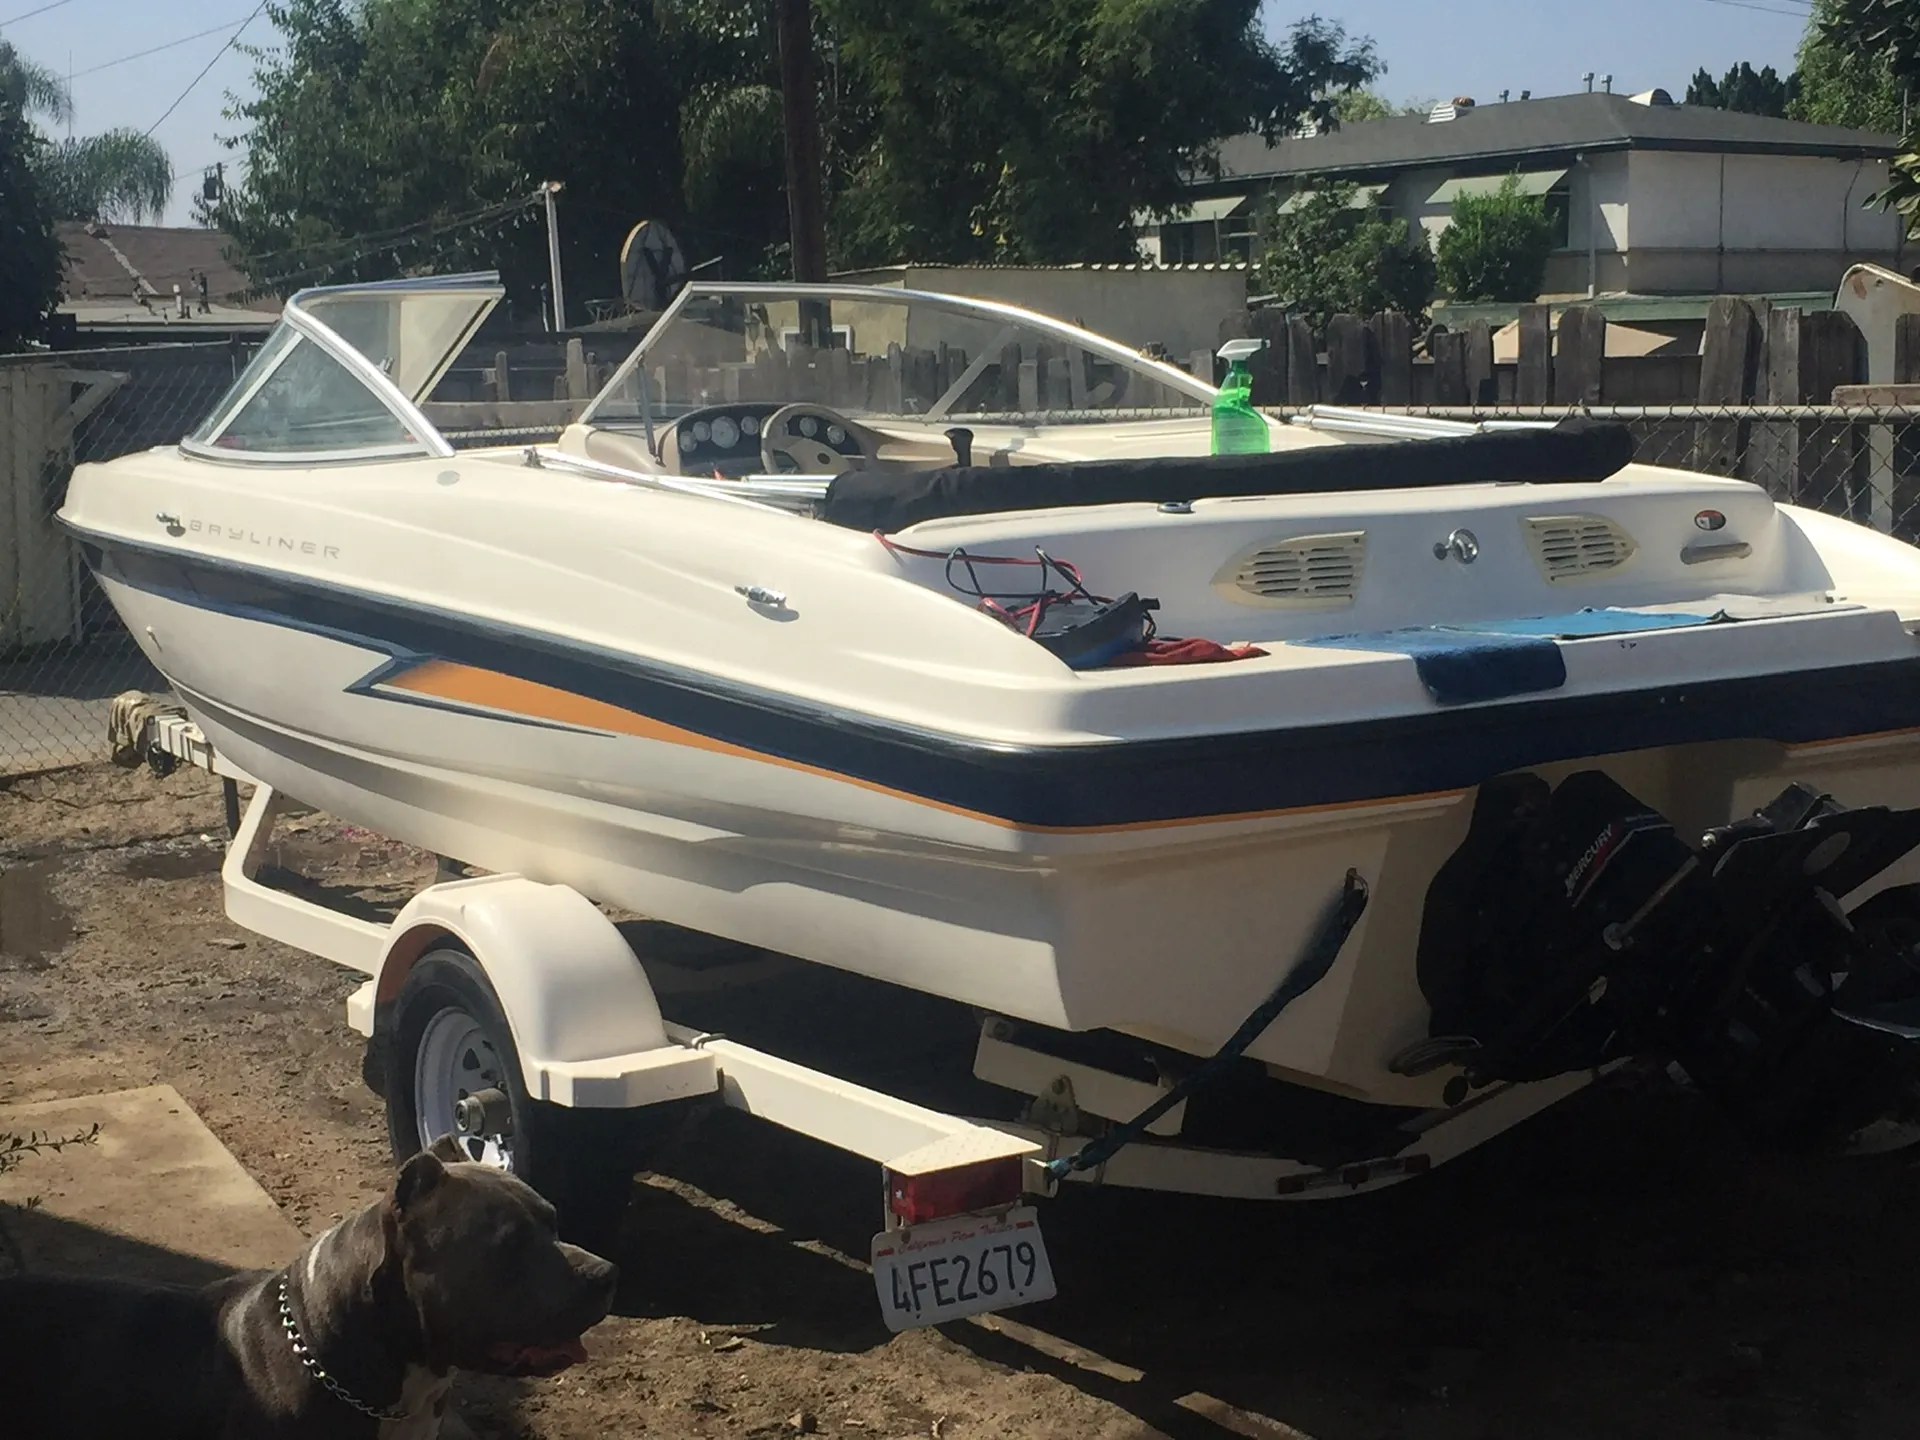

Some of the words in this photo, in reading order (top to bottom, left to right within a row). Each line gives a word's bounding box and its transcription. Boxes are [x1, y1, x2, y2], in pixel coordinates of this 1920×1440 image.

[189, 519, 341, 560] BAYLINER
[1564, 823, 1612, 898] MERCURY
[890, 1240, 1036, 1313] 4FE2679
